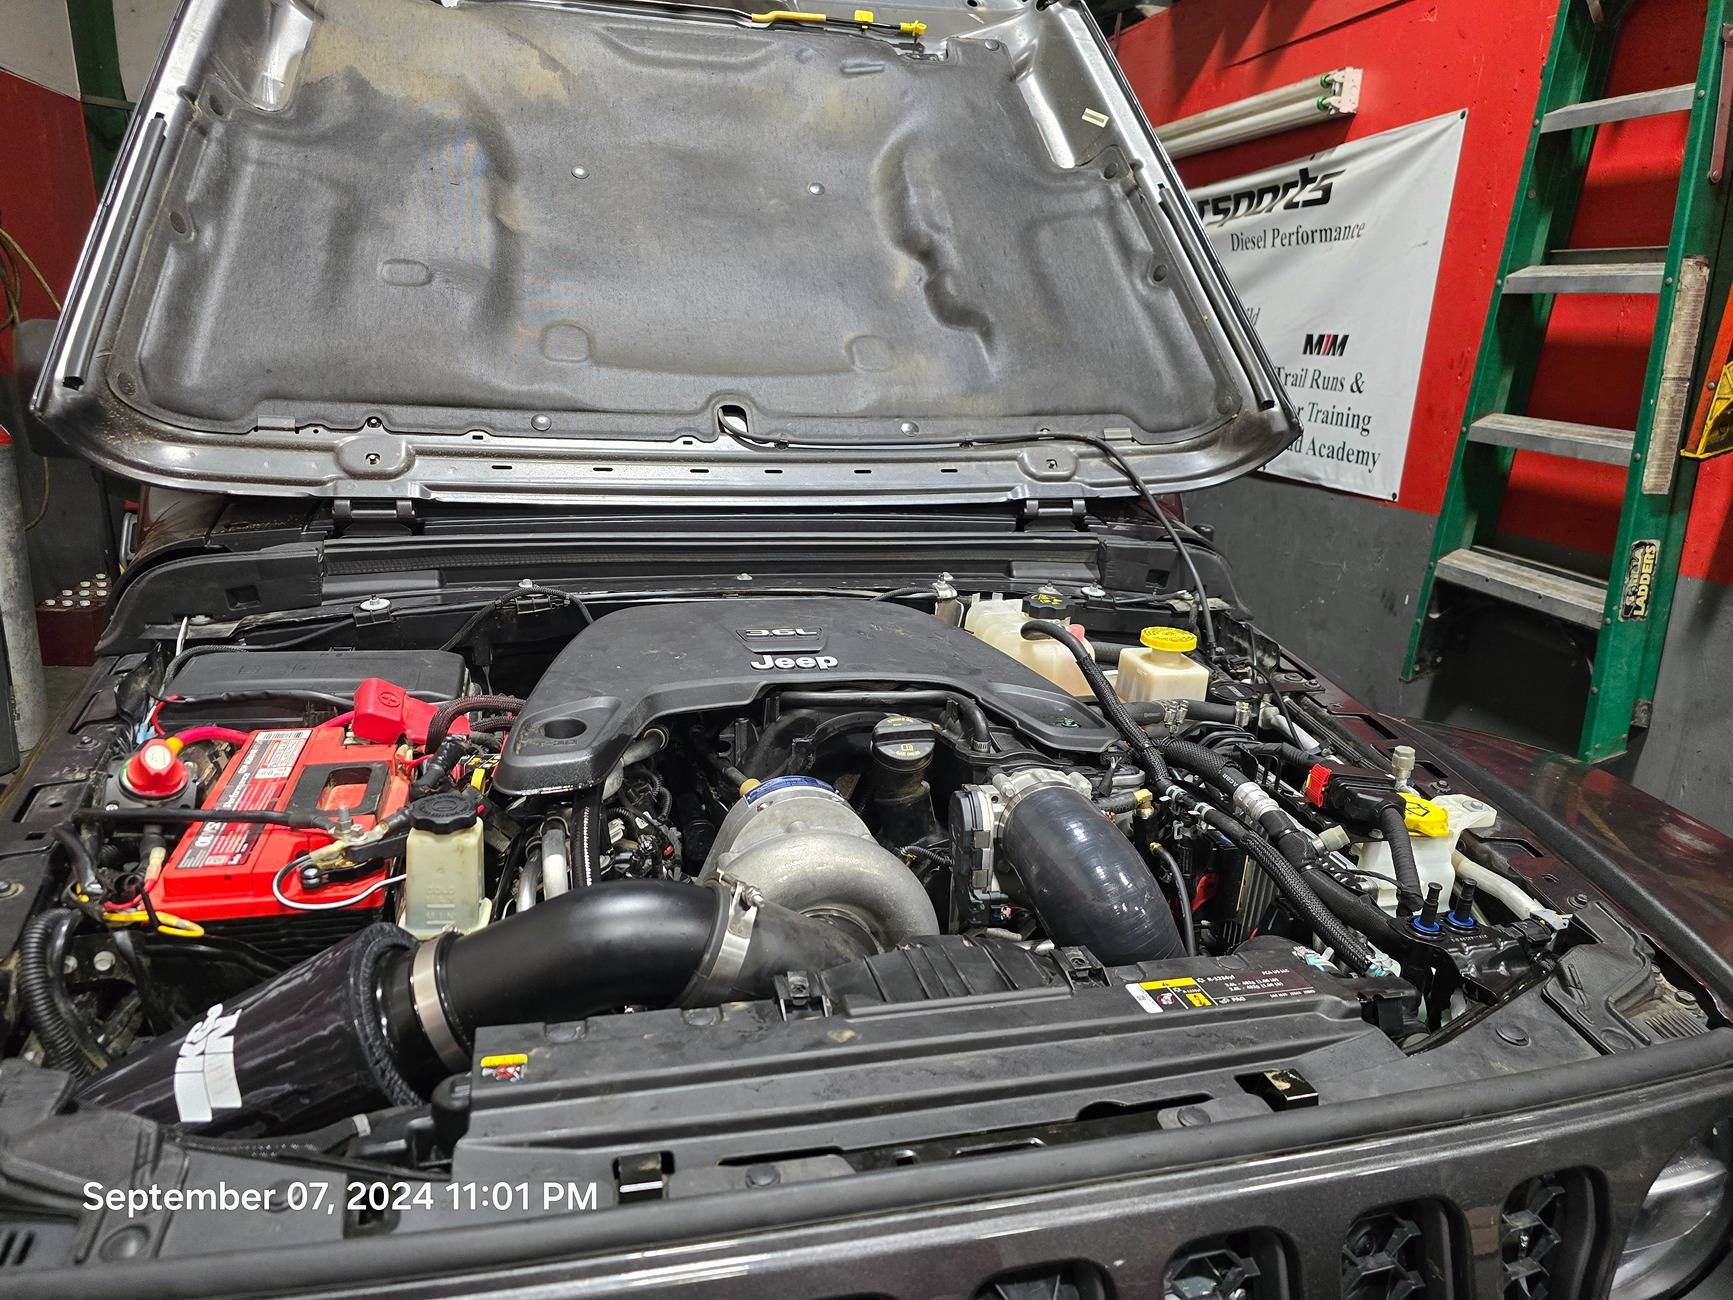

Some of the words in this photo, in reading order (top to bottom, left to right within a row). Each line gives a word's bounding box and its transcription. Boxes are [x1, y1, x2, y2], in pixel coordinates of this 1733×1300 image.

[1230, 229, 1267, 251] Diesel
[1271, 222, 1366, 248] Performance
[1274, 366, 1309, 388] Trail
[1309, 368, 1346, 393] Runs
[1350, 371, 1365, 394] &
[1307, 401, 1372, 437] Training
[1305, 435, 1381, 473] Academy
[1633, 544, 1656, 616] LADDERS
[745, 628, 817, 637] 3.6L
[750, 654, 838, 671] Jeep
